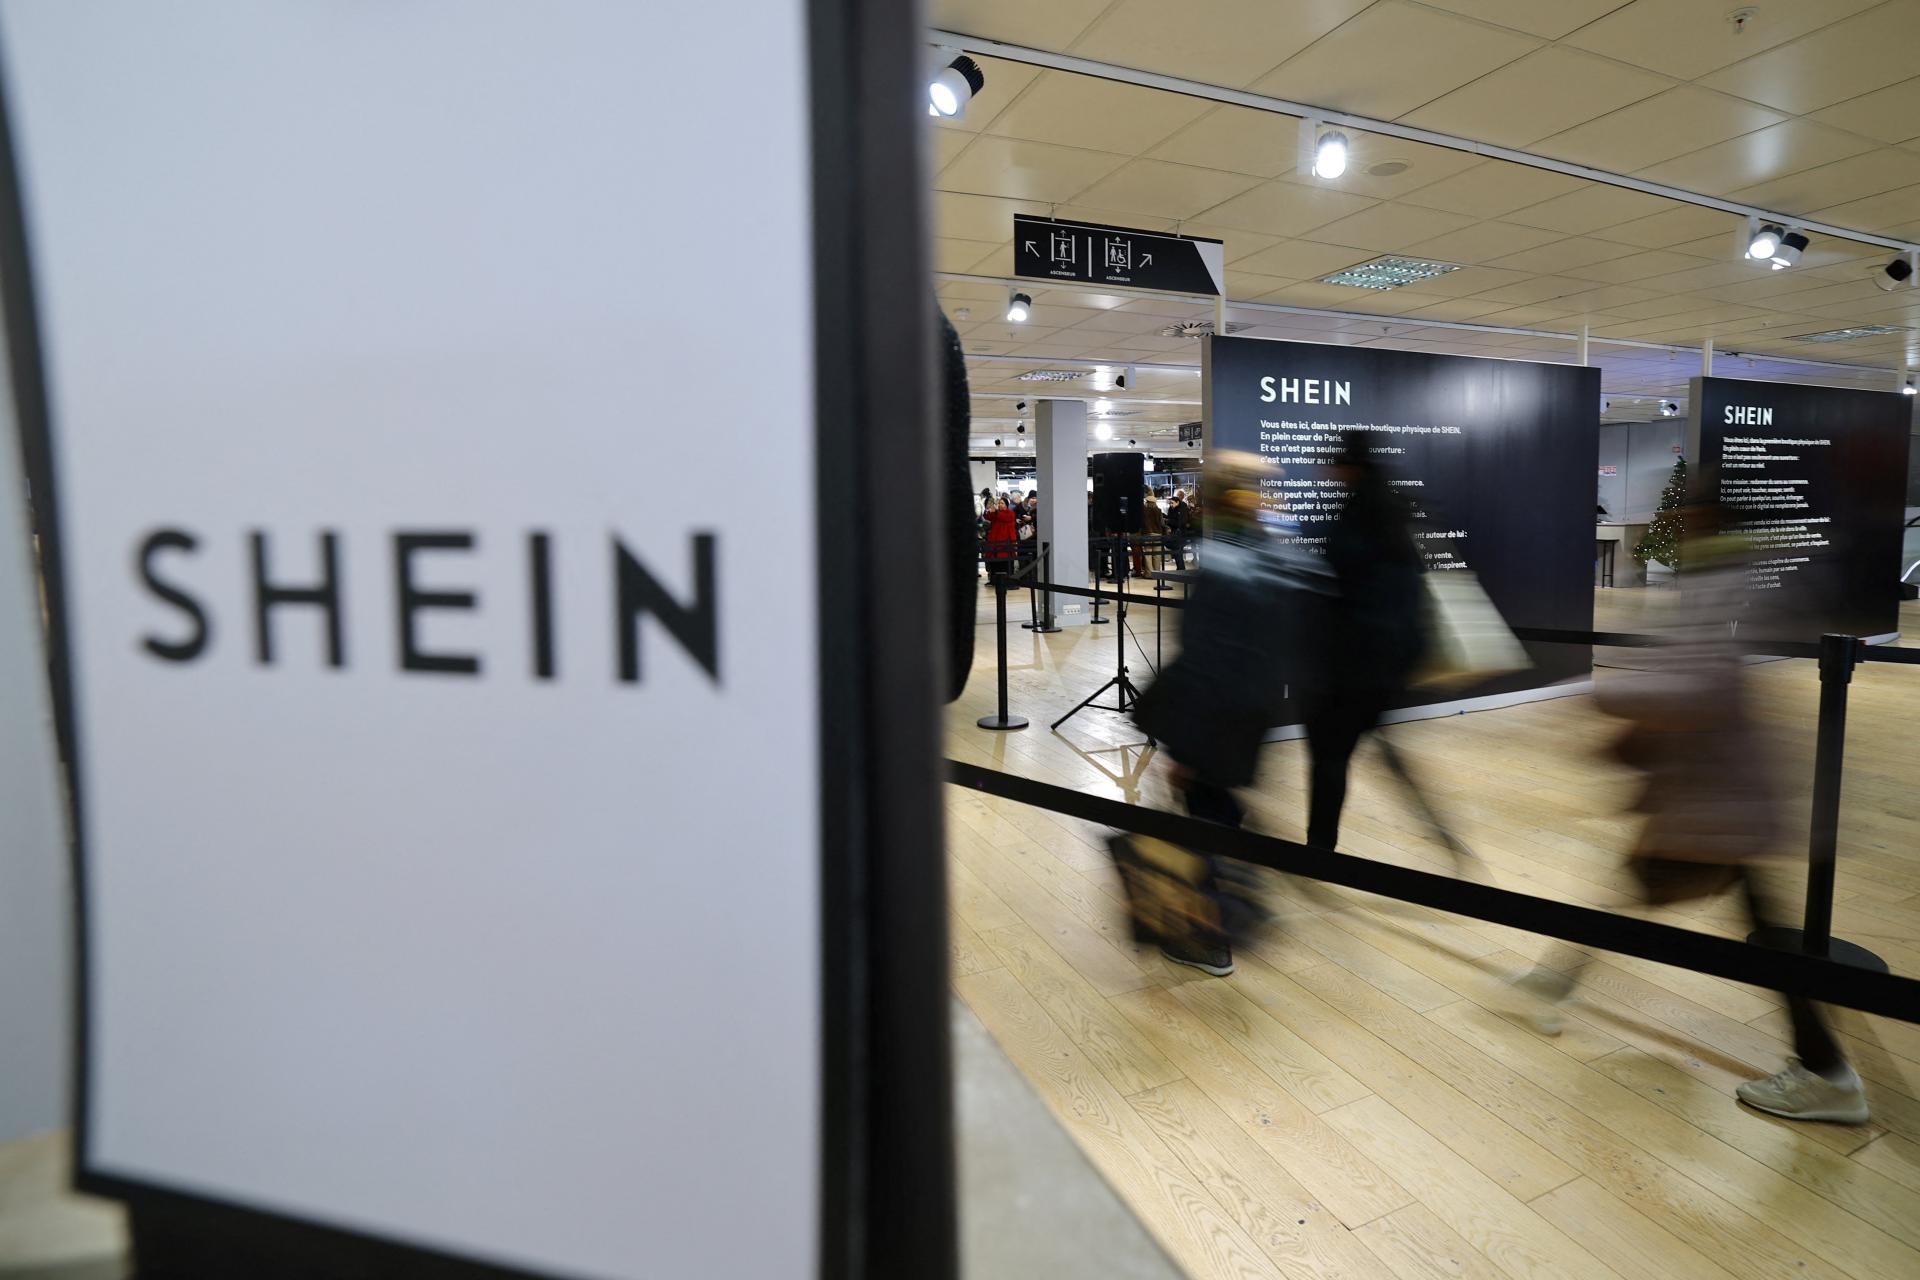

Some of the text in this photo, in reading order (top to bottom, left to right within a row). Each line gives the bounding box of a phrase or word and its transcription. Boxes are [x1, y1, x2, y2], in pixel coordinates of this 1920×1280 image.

[1259, 376, 1351, 406] SHEIN
[1724, 405, 1773, 426] SHEIN
[1260, 420, 1280, 430] Vous
[1281, 420, 1298, 430] êtes
[1298, 421, 1310, 431] ici,
[1311, 422, 1329, 430] dans
[1330, 422, 1337, 431] la
[1338, 423, 1370, 433] première
[1370, 423, 1401, 434] boutique
[1402, 424, 1432, 435] physique
[1432, 426, 1441, 434] de
[1260, 432, 1271, 441] En
[1272, 432, 1291, 442] plein
[1313, 433, 1322, 442] de
[1324, 433, 1344, 442] Paris.
[1260, 444, 1270, 452] Et
[1301, 446, 1316, 454] pas
[1281, 456, 1291, 464] un
[1292, 456, 1316, 464] retour
[1260, 479, 1282, 487] Notre
[1284, 492, 1302, 500] peut
[1273, 503, 1291, 512] peut
[1292, 502, 1315, 512] parler
[1316, 502, 1322, 510] à
[1310, 515, 1324, 523] que
[1326, 513, 1332, 522] le
[1290, 536, 1327, 544] vêtement
[134, 527, 725, 690] SHEIN
